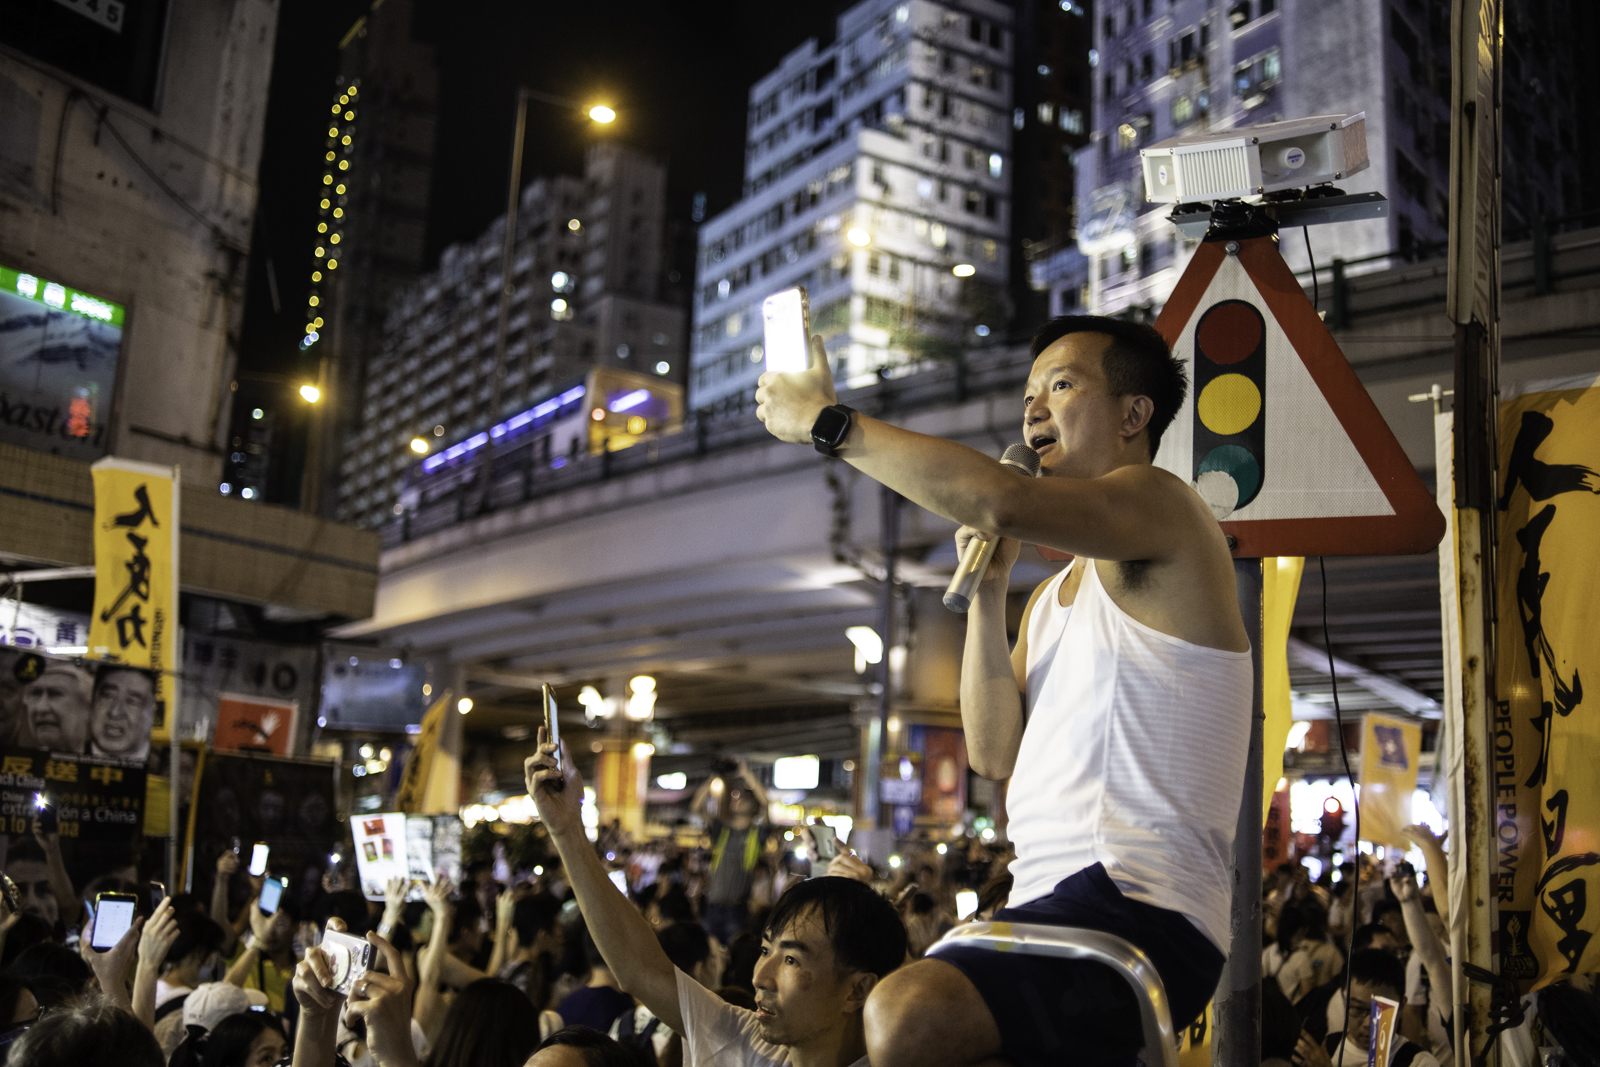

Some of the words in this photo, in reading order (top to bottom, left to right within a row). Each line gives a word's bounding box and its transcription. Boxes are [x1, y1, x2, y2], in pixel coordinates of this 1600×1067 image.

[1496, 700, 1516, 797] PEOPLE
[94, 806, 137, 824] China
[1498, 804, 1520, 903] POWER
